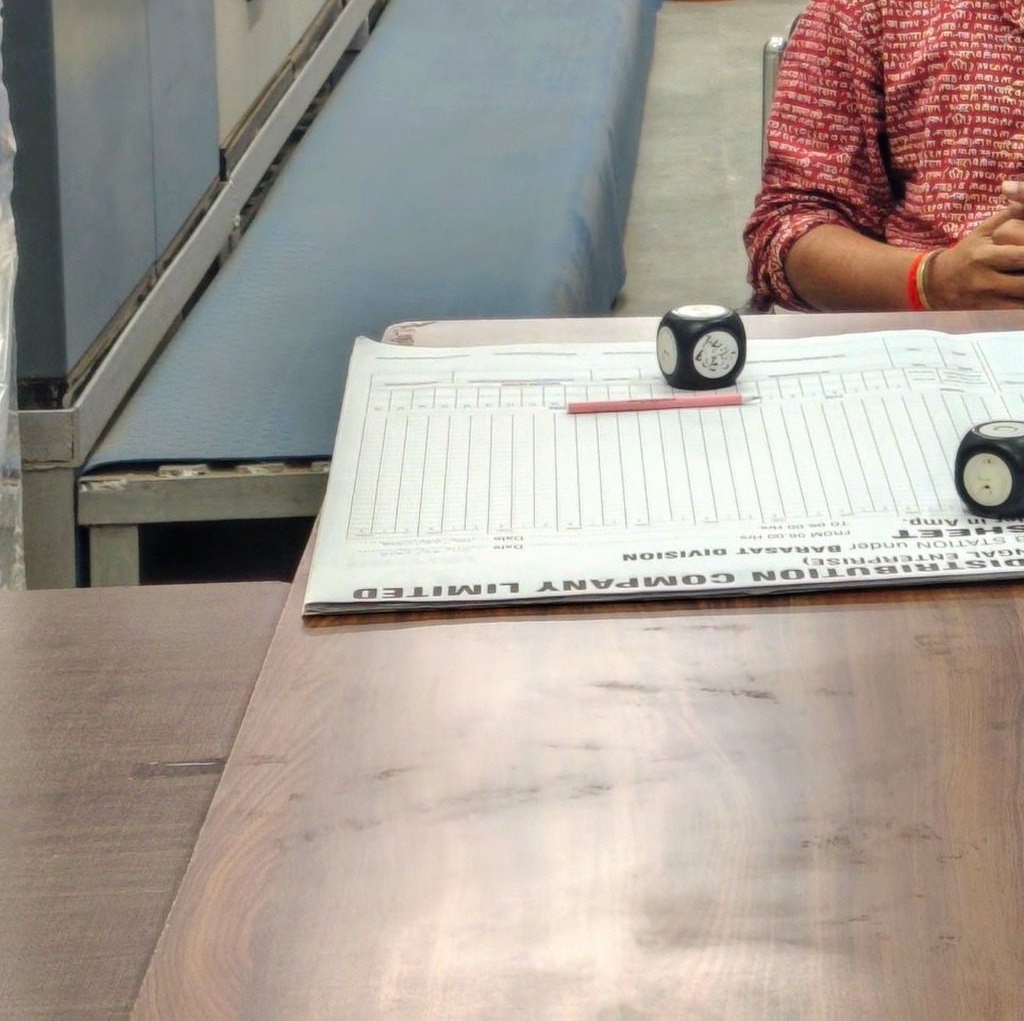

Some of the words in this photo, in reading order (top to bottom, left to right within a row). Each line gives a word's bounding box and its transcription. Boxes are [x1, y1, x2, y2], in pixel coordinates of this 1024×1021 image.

[967, 517, 987, 526] in
[849, 540, 908, 552] under
[917, 536, 1006, 549] STATION
[622, 548, 728, 562] DIVISION
[736, 544, 842, 555] BARASAT
[537, 572, 735, 593] COMPANY
[353, 582, 520, 600] LIMITED
